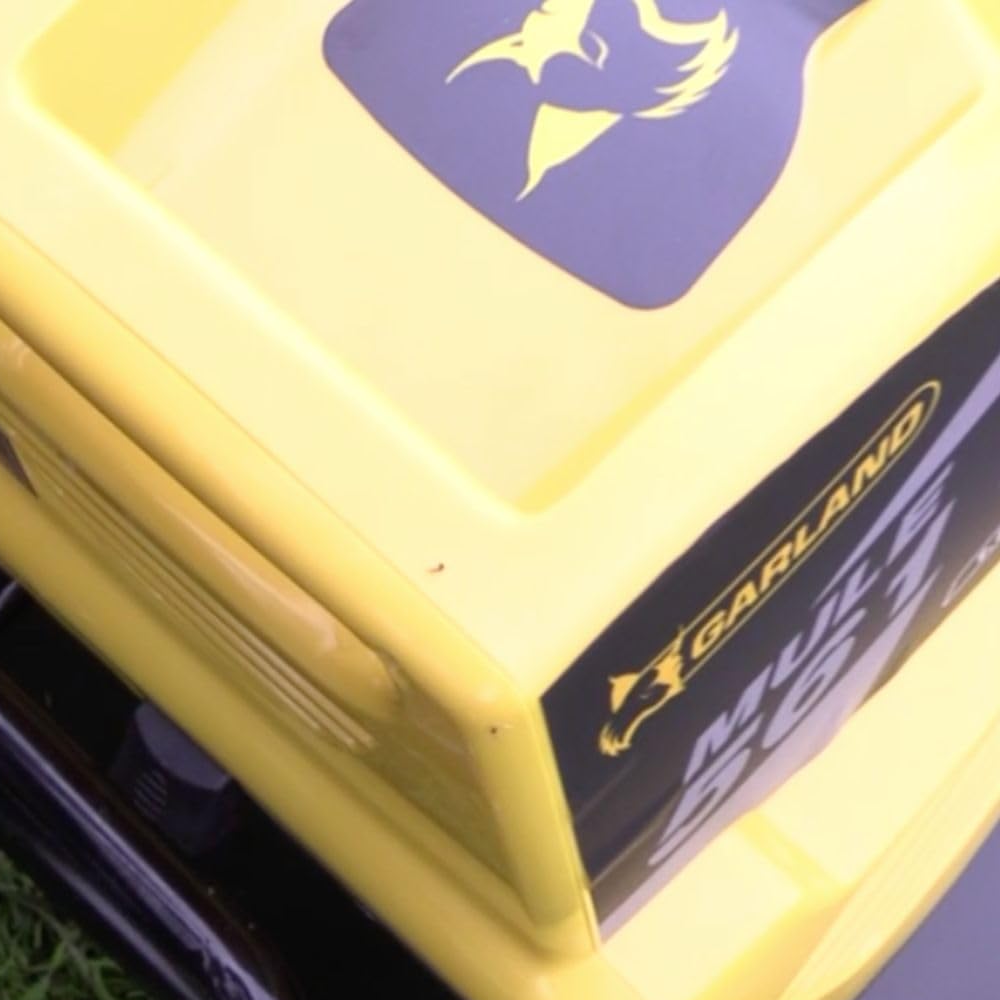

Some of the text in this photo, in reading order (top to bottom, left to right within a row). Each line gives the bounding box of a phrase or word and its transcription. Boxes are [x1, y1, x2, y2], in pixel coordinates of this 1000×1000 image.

[648, 499, 956, 867] 561
[683, 461, 954, 786] MULE
[691, 401, 924, 660] GARLAND
